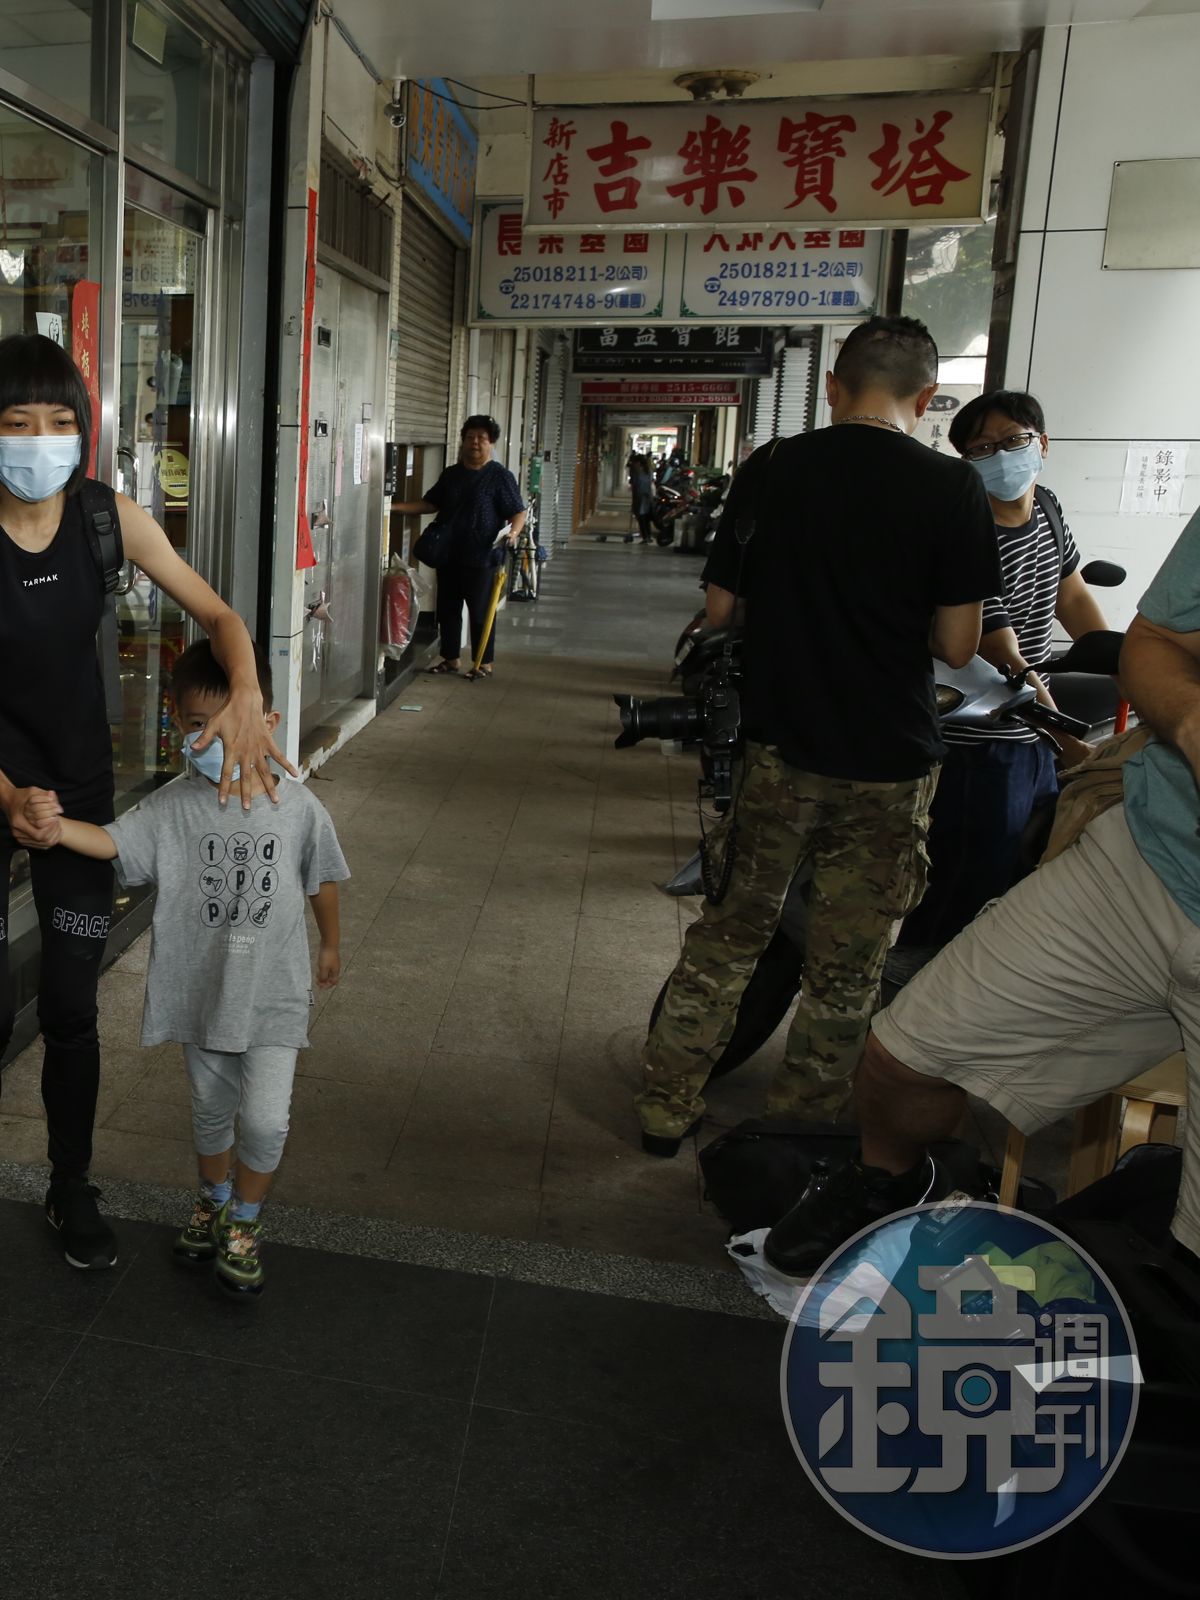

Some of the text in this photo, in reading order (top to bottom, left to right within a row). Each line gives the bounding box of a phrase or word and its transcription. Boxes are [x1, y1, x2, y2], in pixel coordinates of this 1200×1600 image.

[542, 116, 578, 220] 新店市
[586, 109, 970, 214] 吉樂寶塔
[513, 265, 648, 282] 25018211-2(公司)
[719, 261, 864, 280] 25018211-2(公司)
[1153, 450, 1174, 502] 錄影中
[22, 573, 58, 587] TARMAK
[52, 906, 111, 939] SPACE
